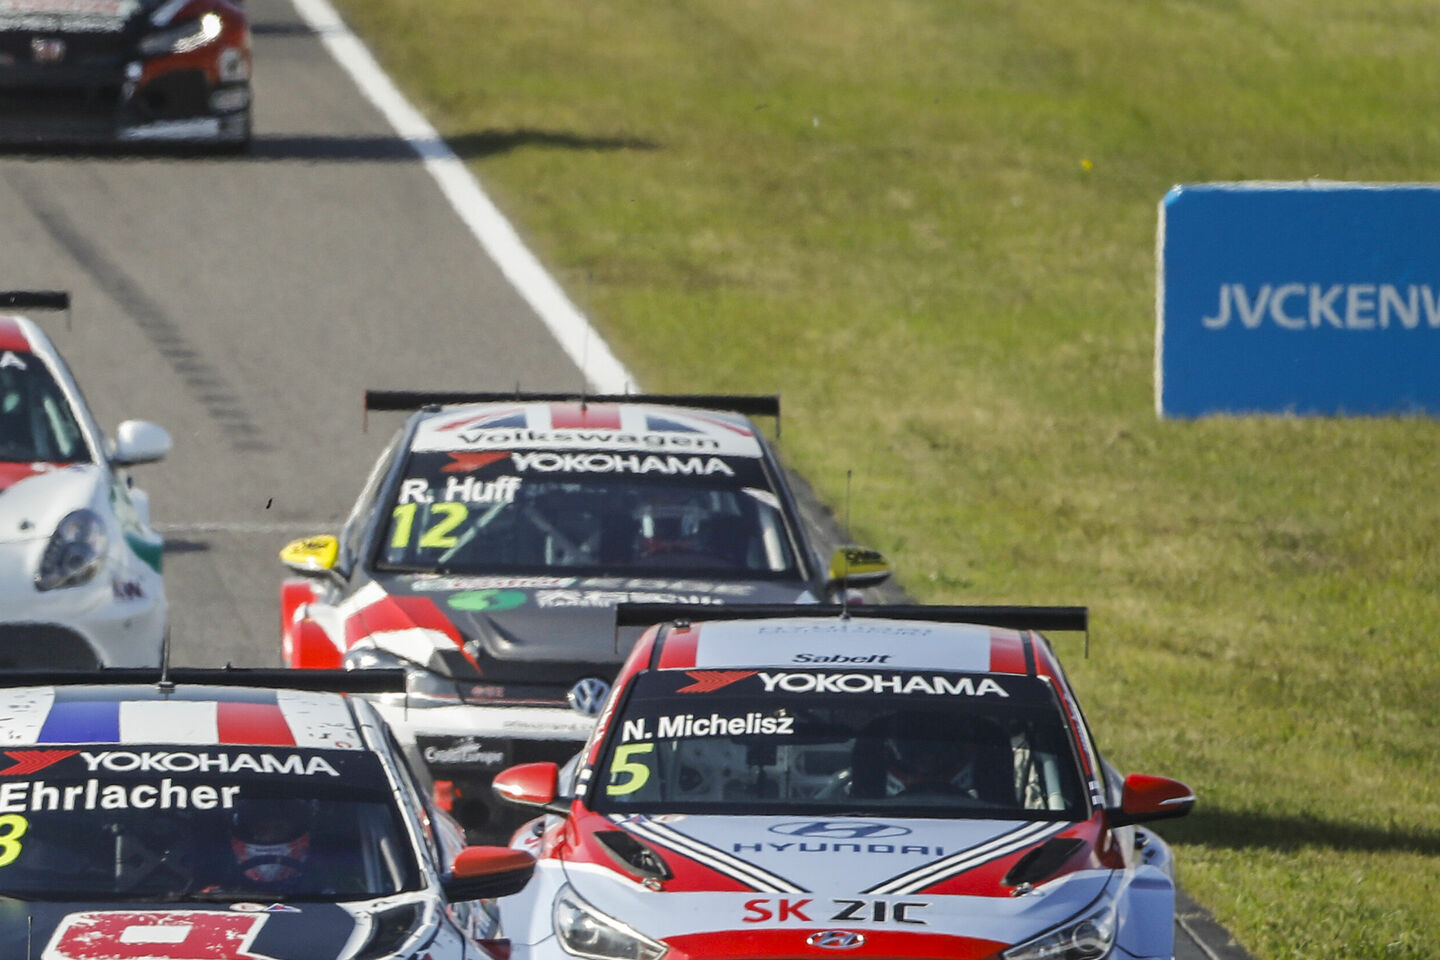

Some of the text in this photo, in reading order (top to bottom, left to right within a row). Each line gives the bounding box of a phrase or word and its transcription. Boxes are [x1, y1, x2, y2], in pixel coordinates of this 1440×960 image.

[458, 430, 721, 449] Volkswagen
[511, 452, 735, 477] YOKOHAMA
[398, 475, 523, 504] R. Huff
[391, 502, 470, 549] 12
[792, 653, 892, 665] Sabelt
[758, 672, 1010, 698] YOKOHAMA
[621, 720, 653, 742] N.
[79, 751, 341, 776] YOKOHAMA
[606, 743, 655, 797] 5
[733, 842, 945, 856] HYUNDAI
[741, 898, 934, 926] SK ZIC
